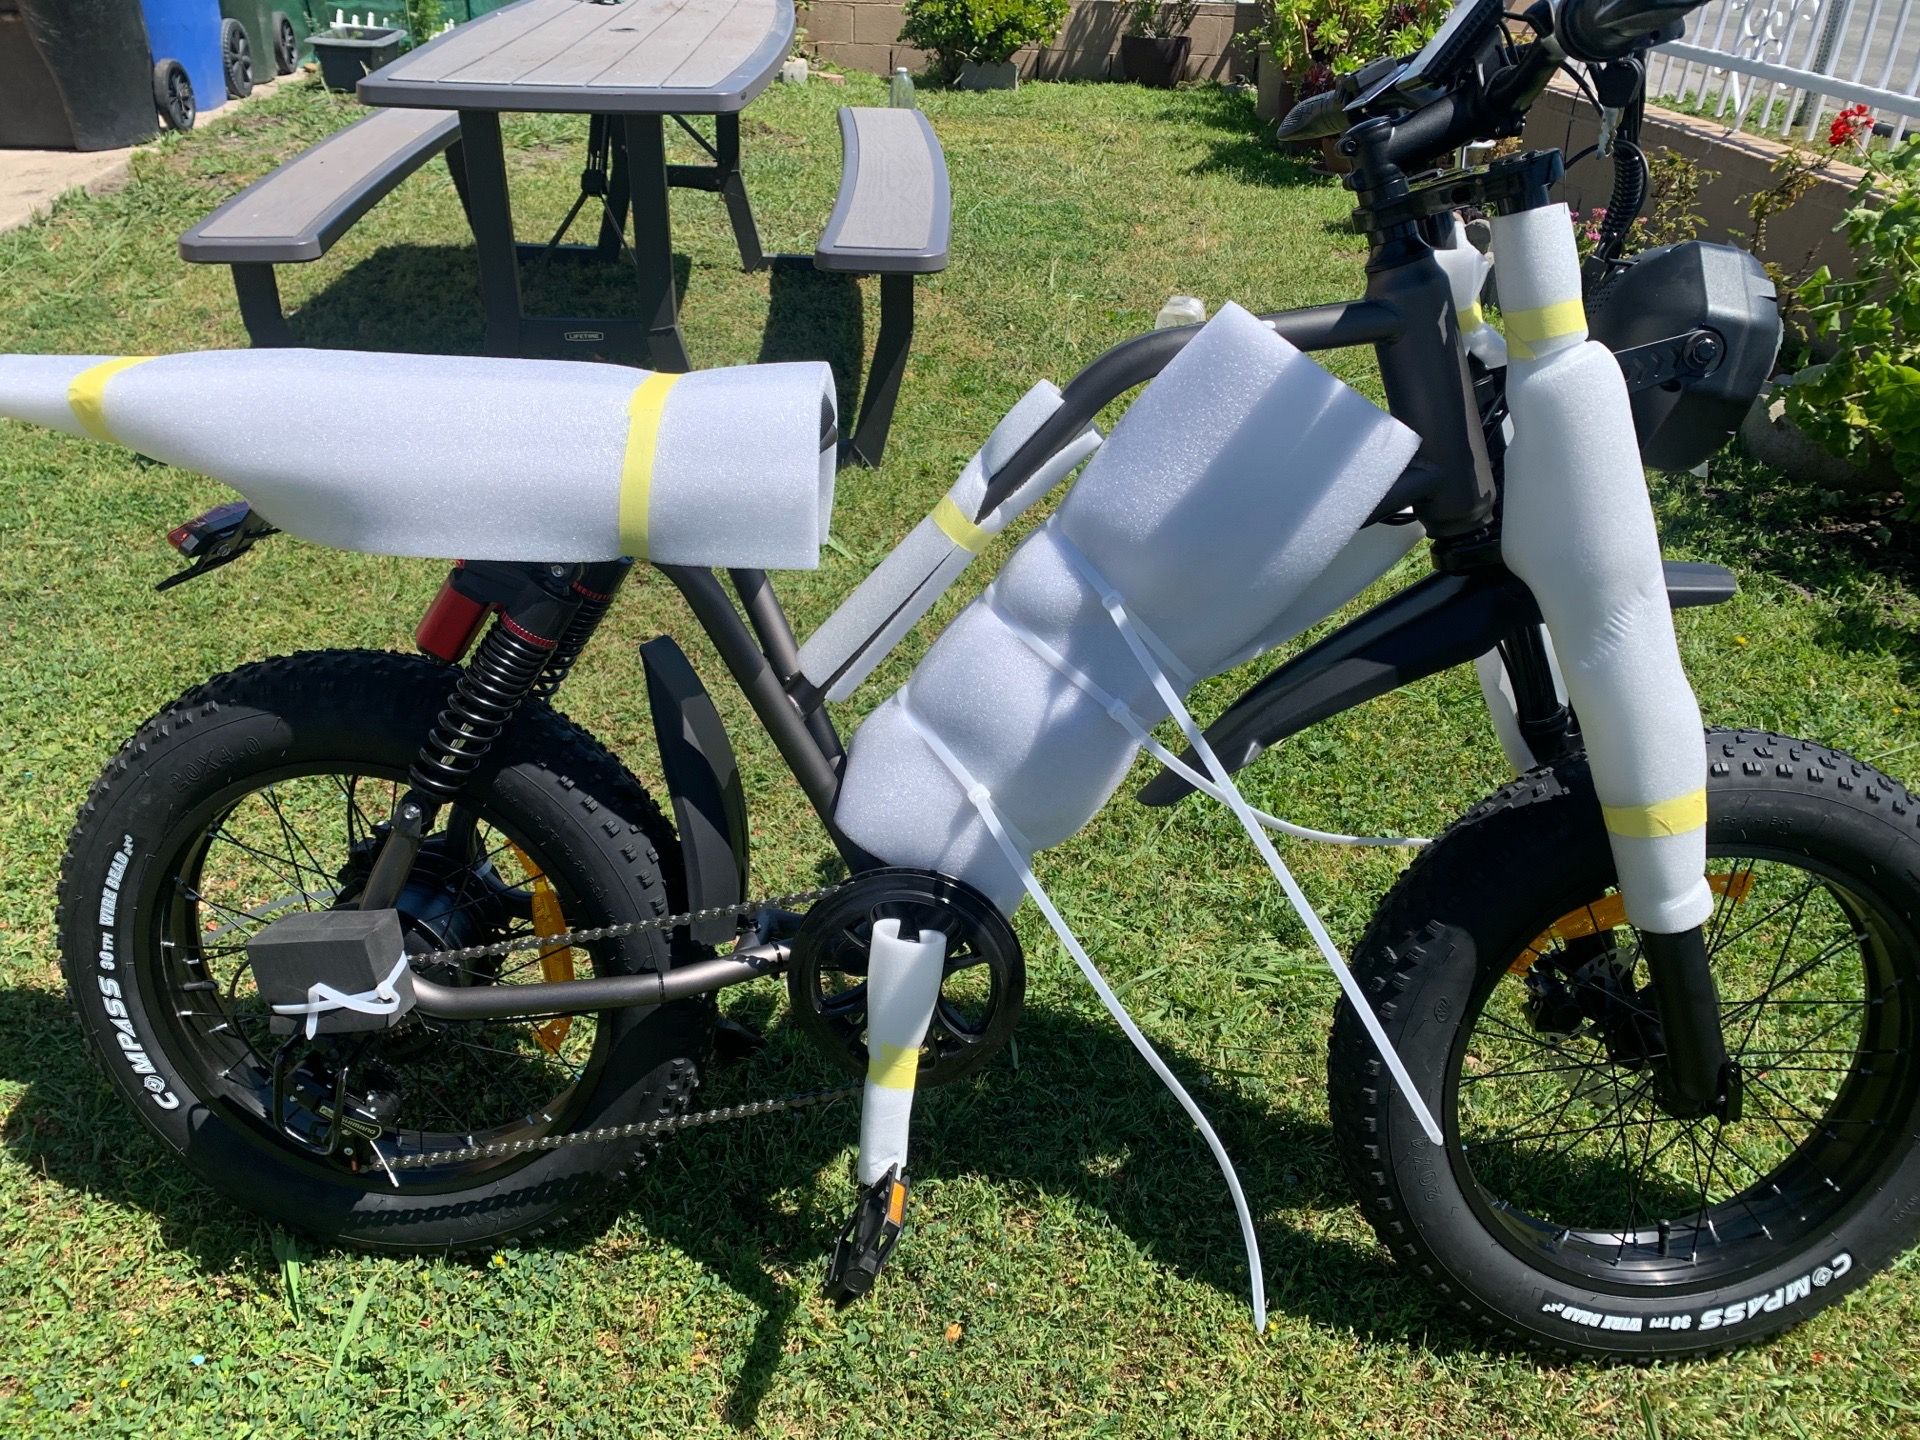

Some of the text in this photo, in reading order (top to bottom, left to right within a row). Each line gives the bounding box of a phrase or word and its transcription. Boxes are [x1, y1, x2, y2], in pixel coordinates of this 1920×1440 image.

[104, 850, 130, 891] BEAD
[99, 886, 118, 927] WIRE
[97, 975, 180, 1110] COMPASS
[1697, 1252, 1853, 1331] COMPASS
